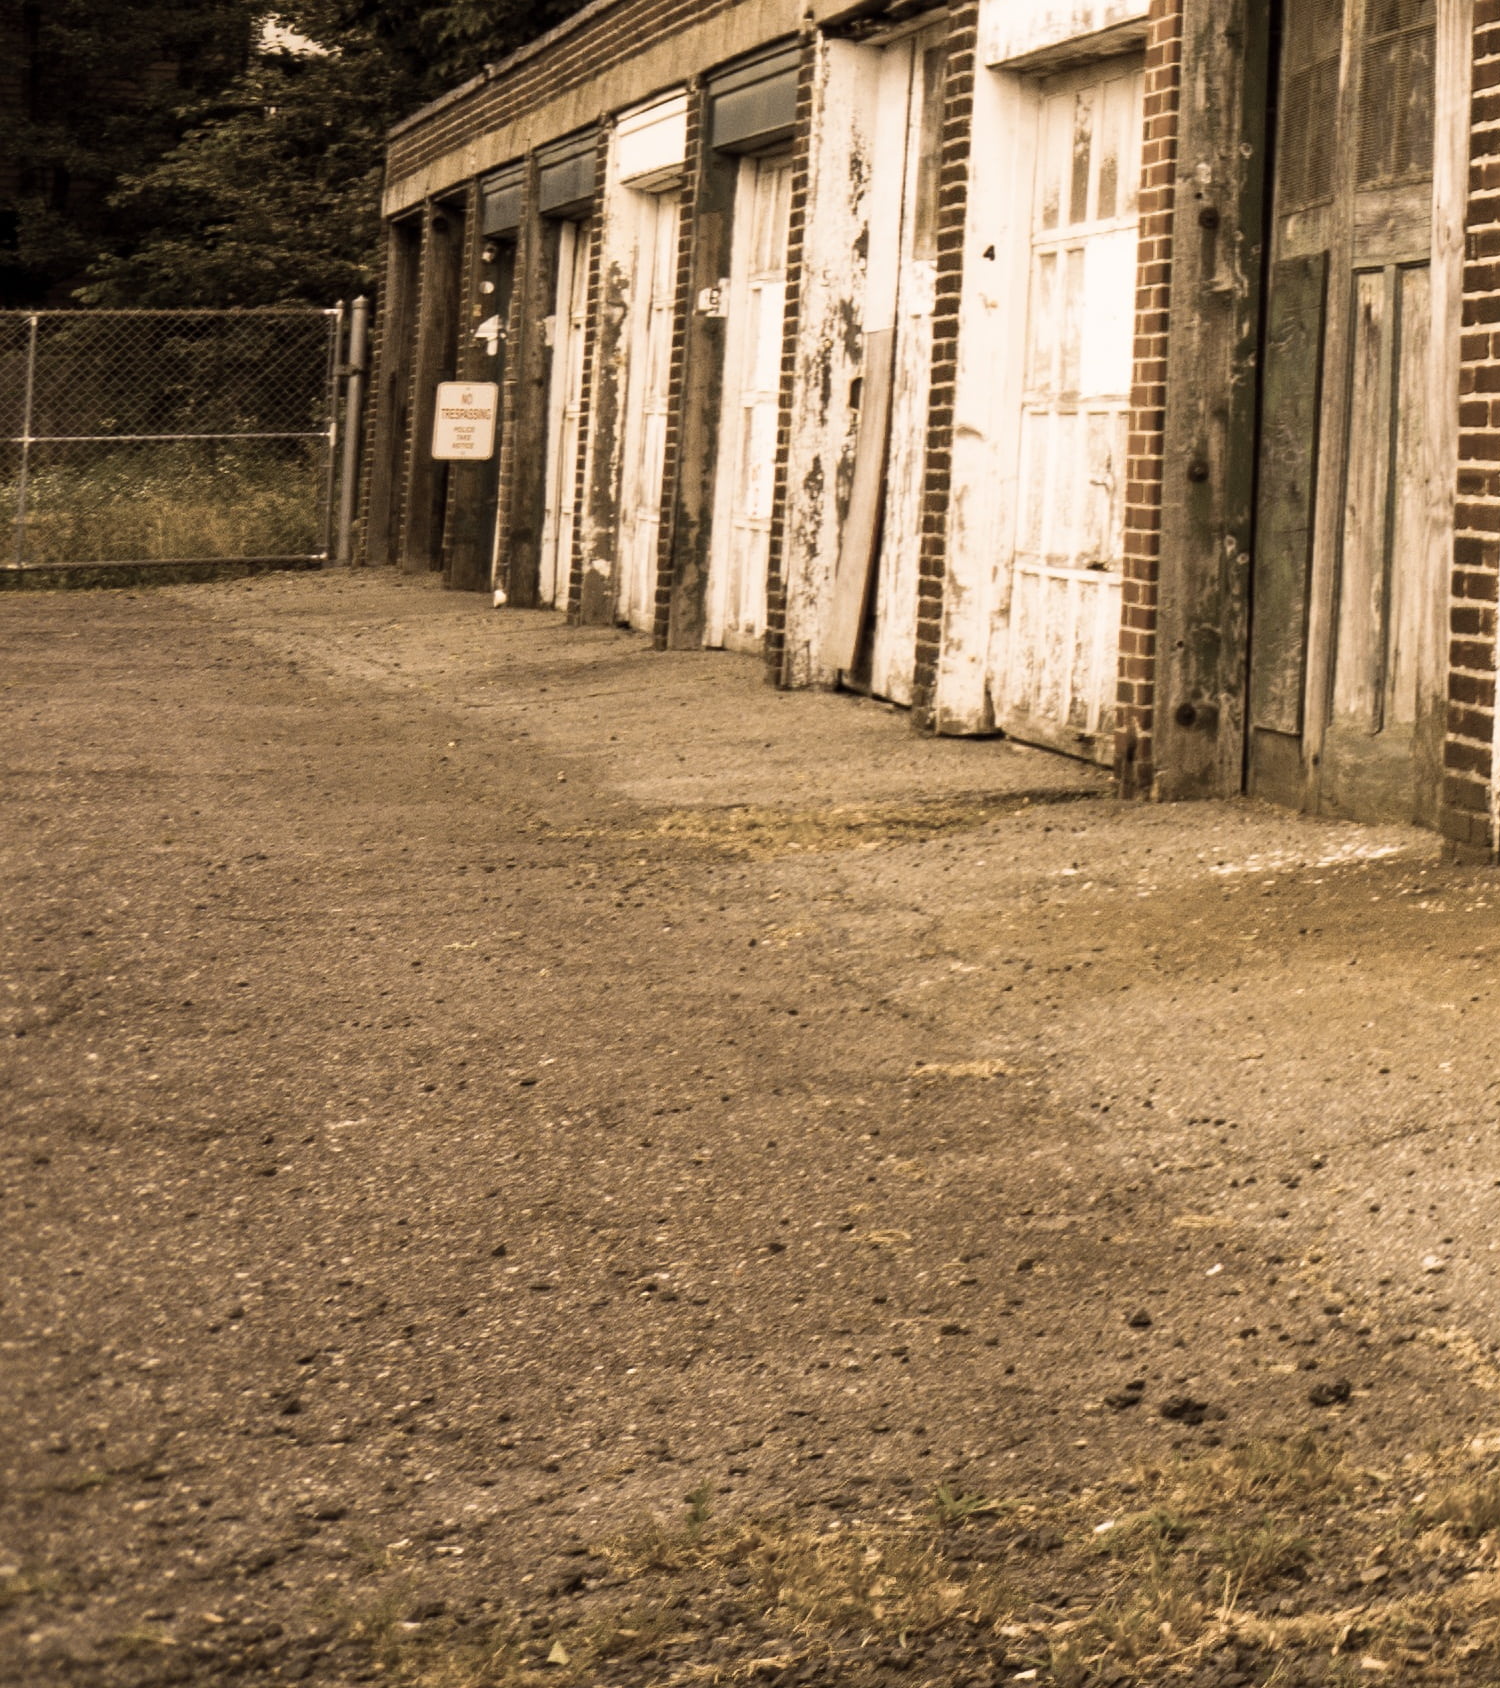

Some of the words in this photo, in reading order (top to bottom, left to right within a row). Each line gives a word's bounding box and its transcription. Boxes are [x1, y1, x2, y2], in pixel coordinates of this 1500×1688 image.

[982, 244, 996, 262] 4
[461, 393, 473, 405] NO
[441, 407, 491, 420] TRESPASSING
